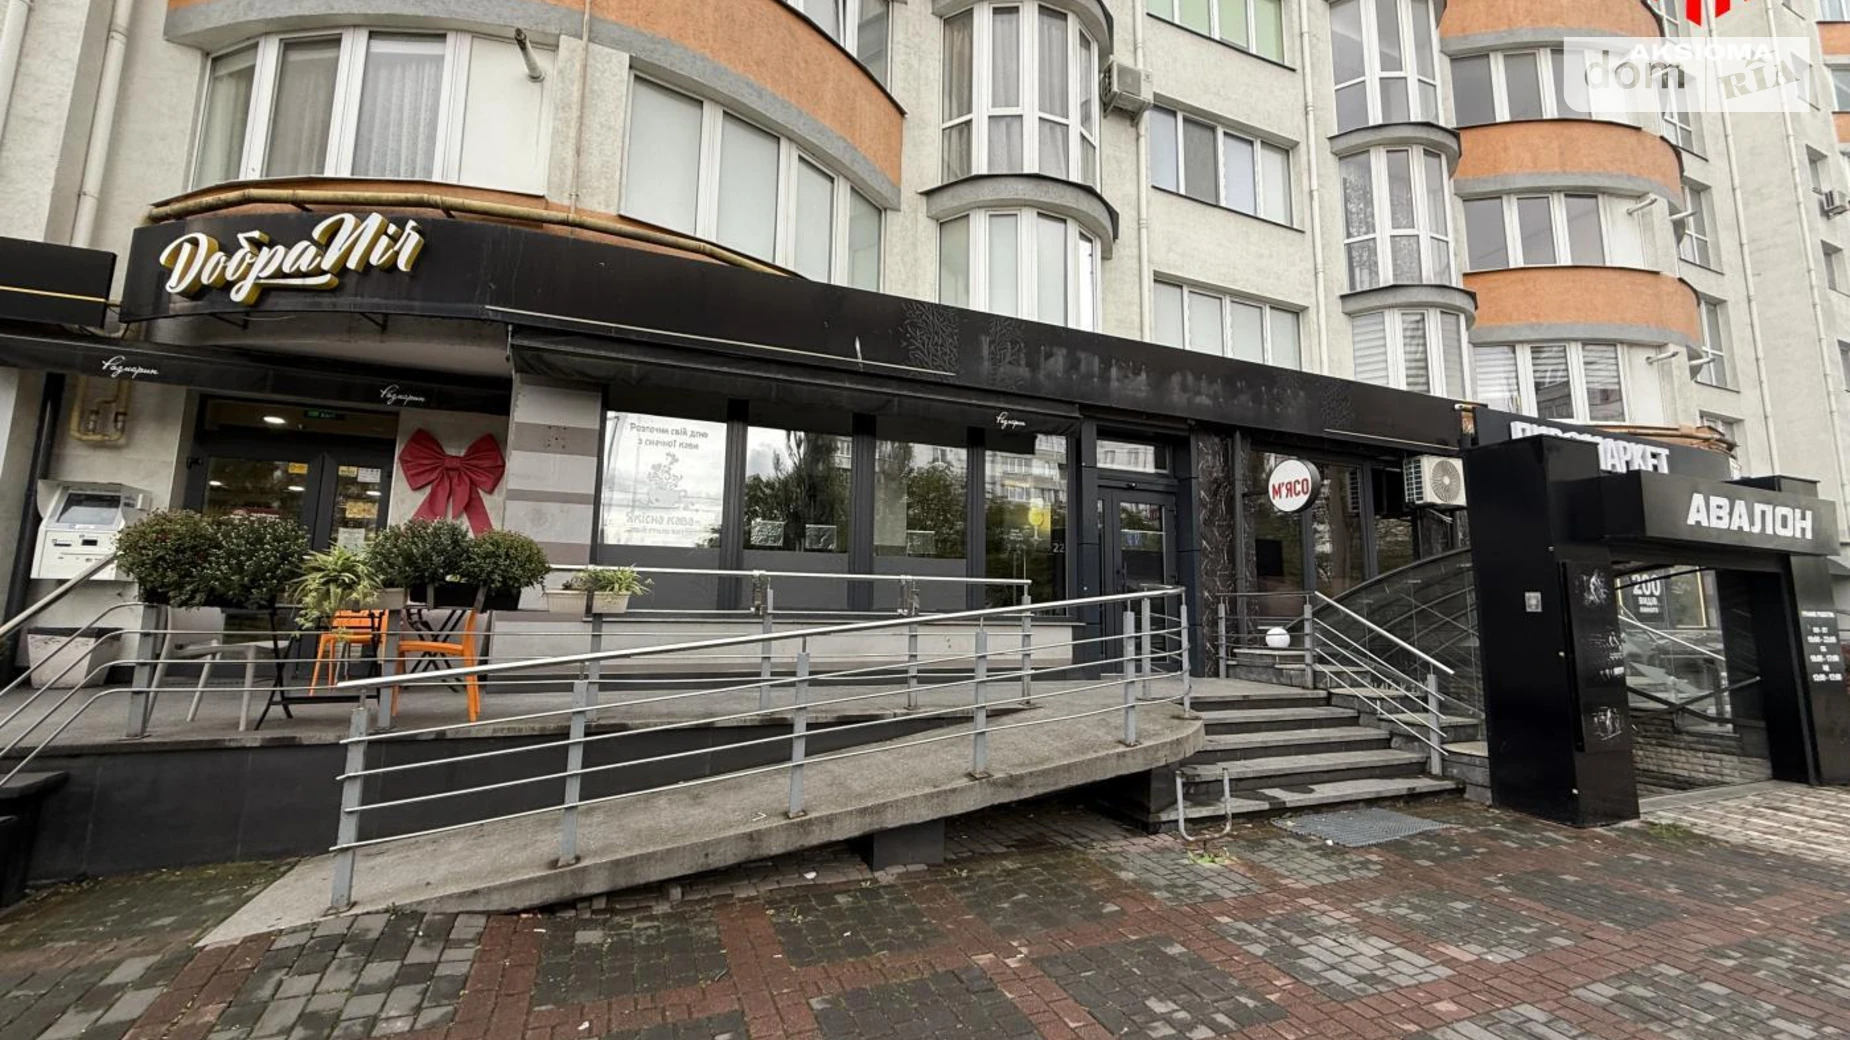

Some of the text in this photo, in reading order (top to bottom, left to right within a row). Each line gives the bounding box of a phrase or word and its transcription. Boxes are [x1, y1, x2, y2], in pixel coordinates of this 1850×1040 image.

[671, 427, 688, 436] свій
[678, 441, 699, 450] кави
[1272, 478, 1309, 500] М'ЯСО
[1686, 492, 1813, 540] АВАЛОН
[1631, 574, 1661, 596] 200
